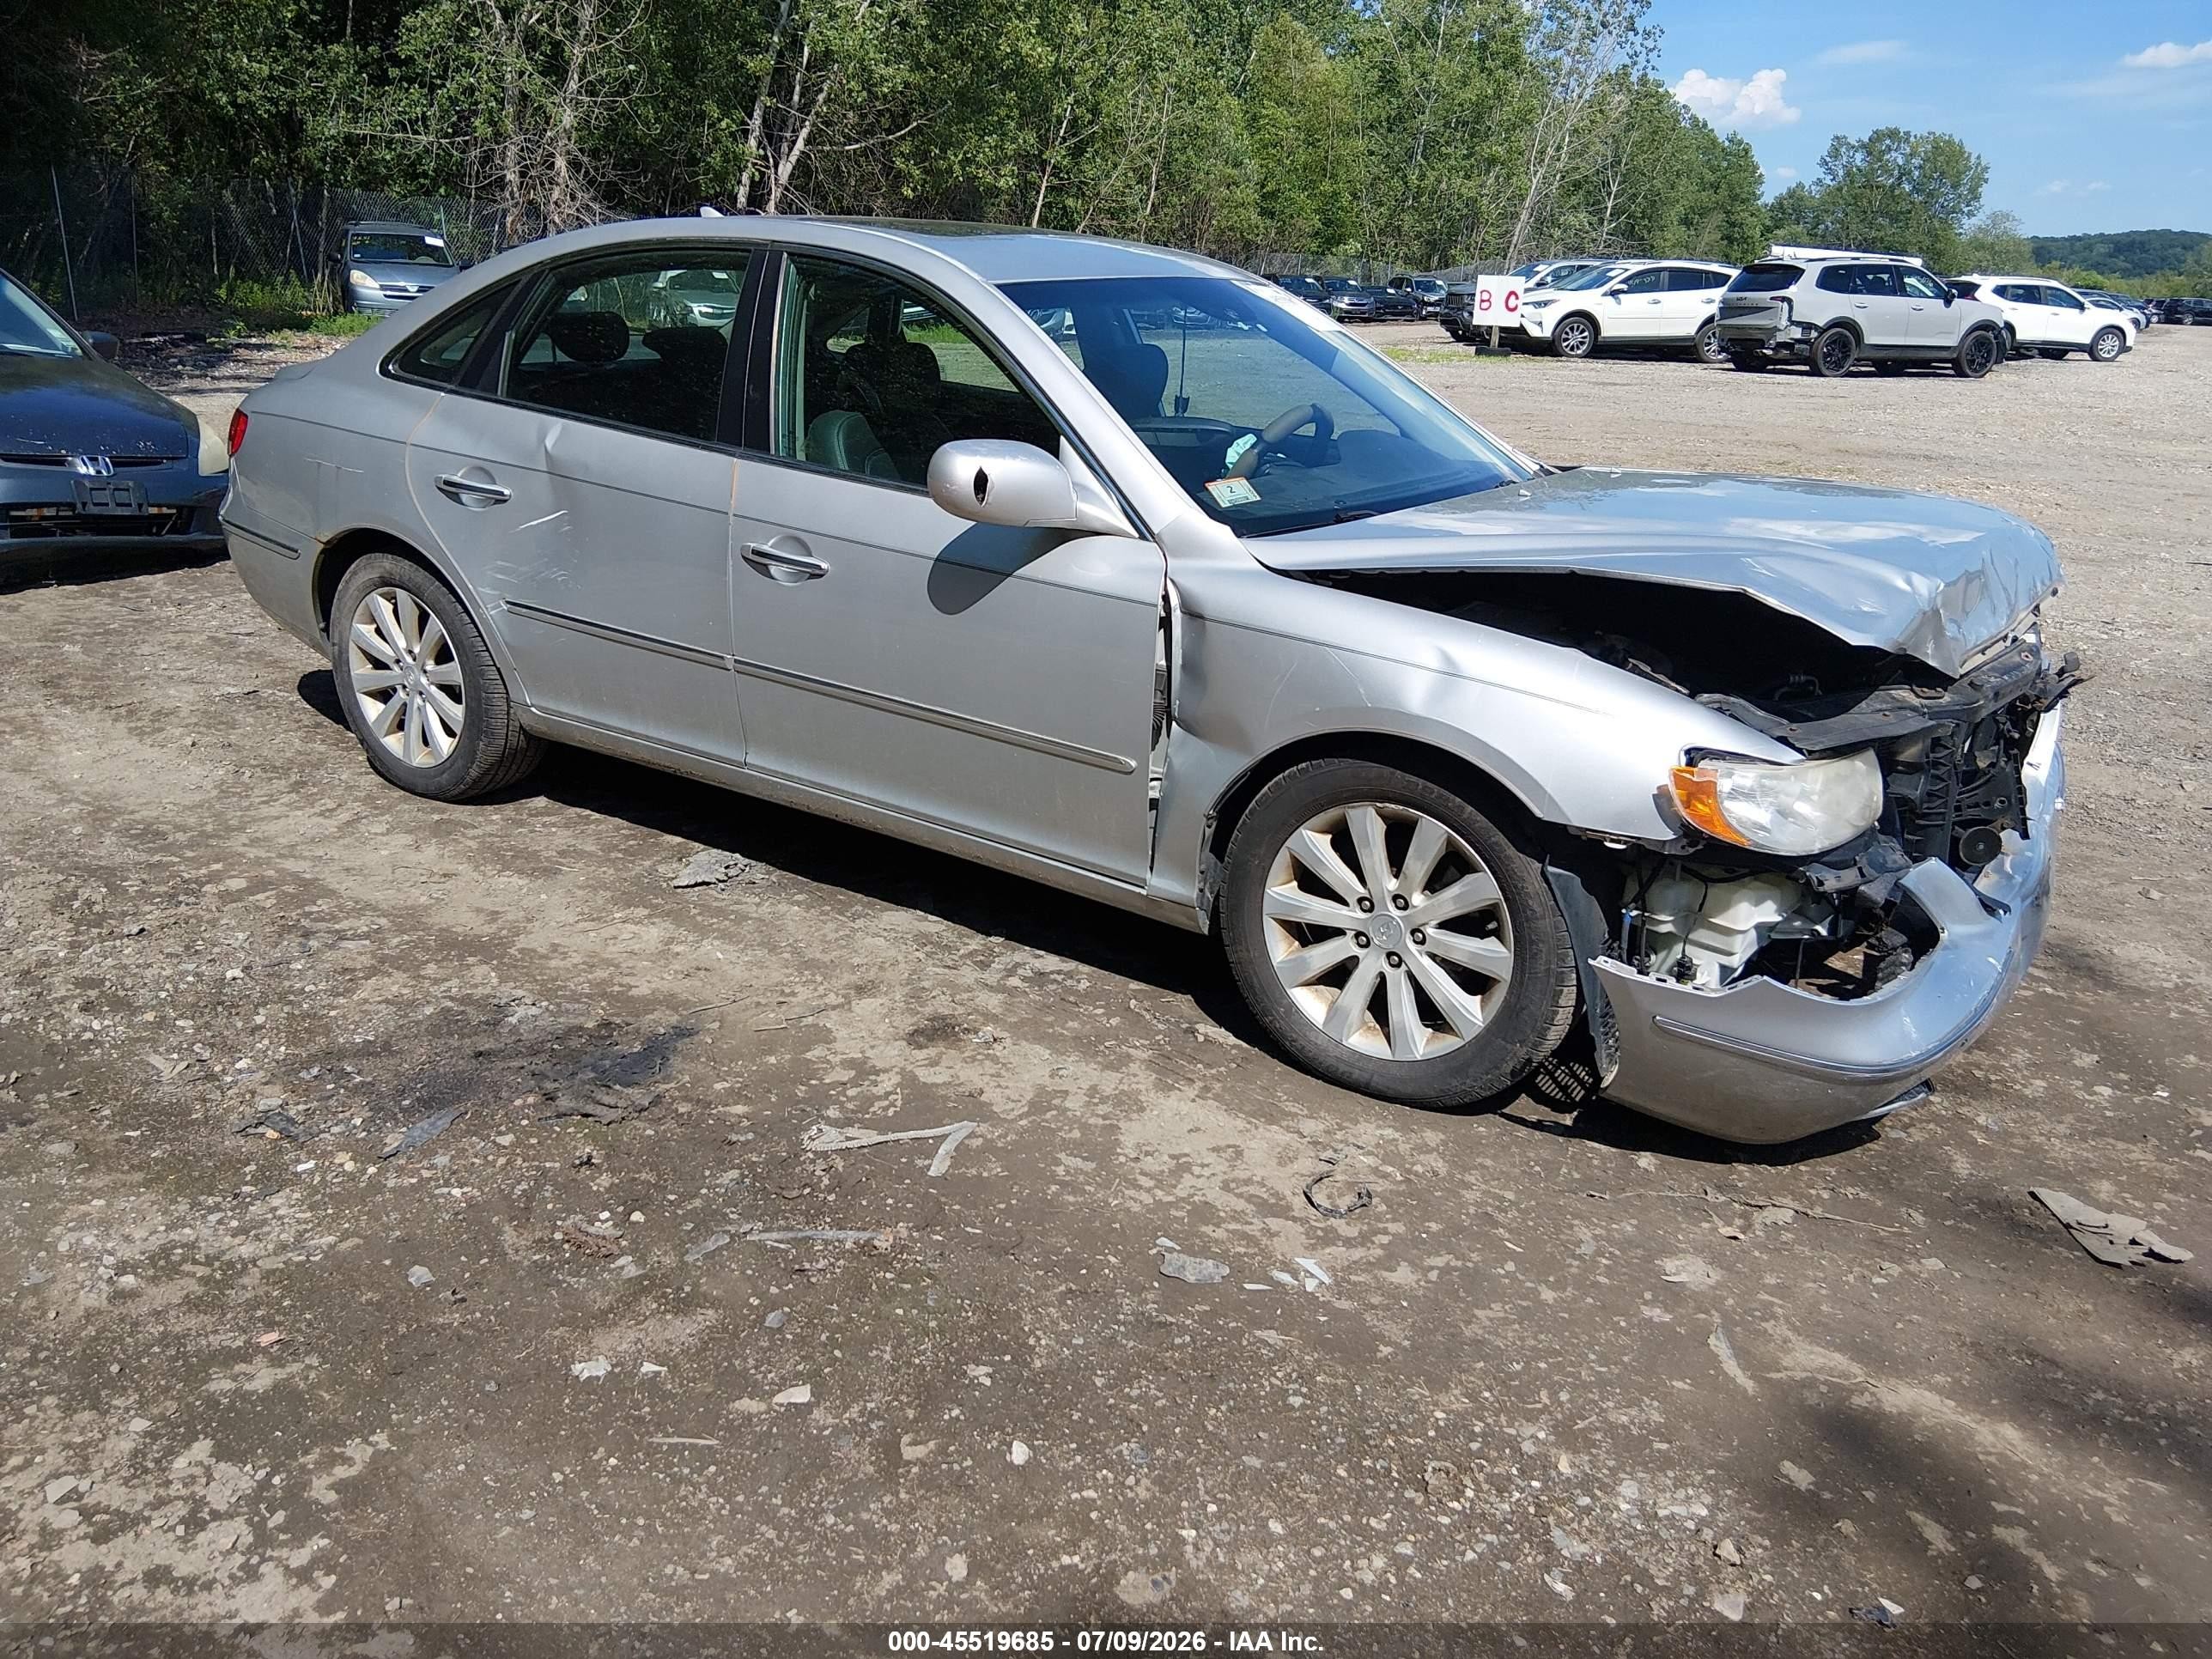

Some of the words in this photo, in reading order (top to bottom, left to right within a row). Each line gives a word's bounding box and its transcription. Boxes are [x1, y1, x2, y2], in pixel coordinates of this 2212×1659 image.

[1480, 289, 1492, 311] B
[1504, 290, 1519, 313] C
[1226, 485, 1237, 494] 2
